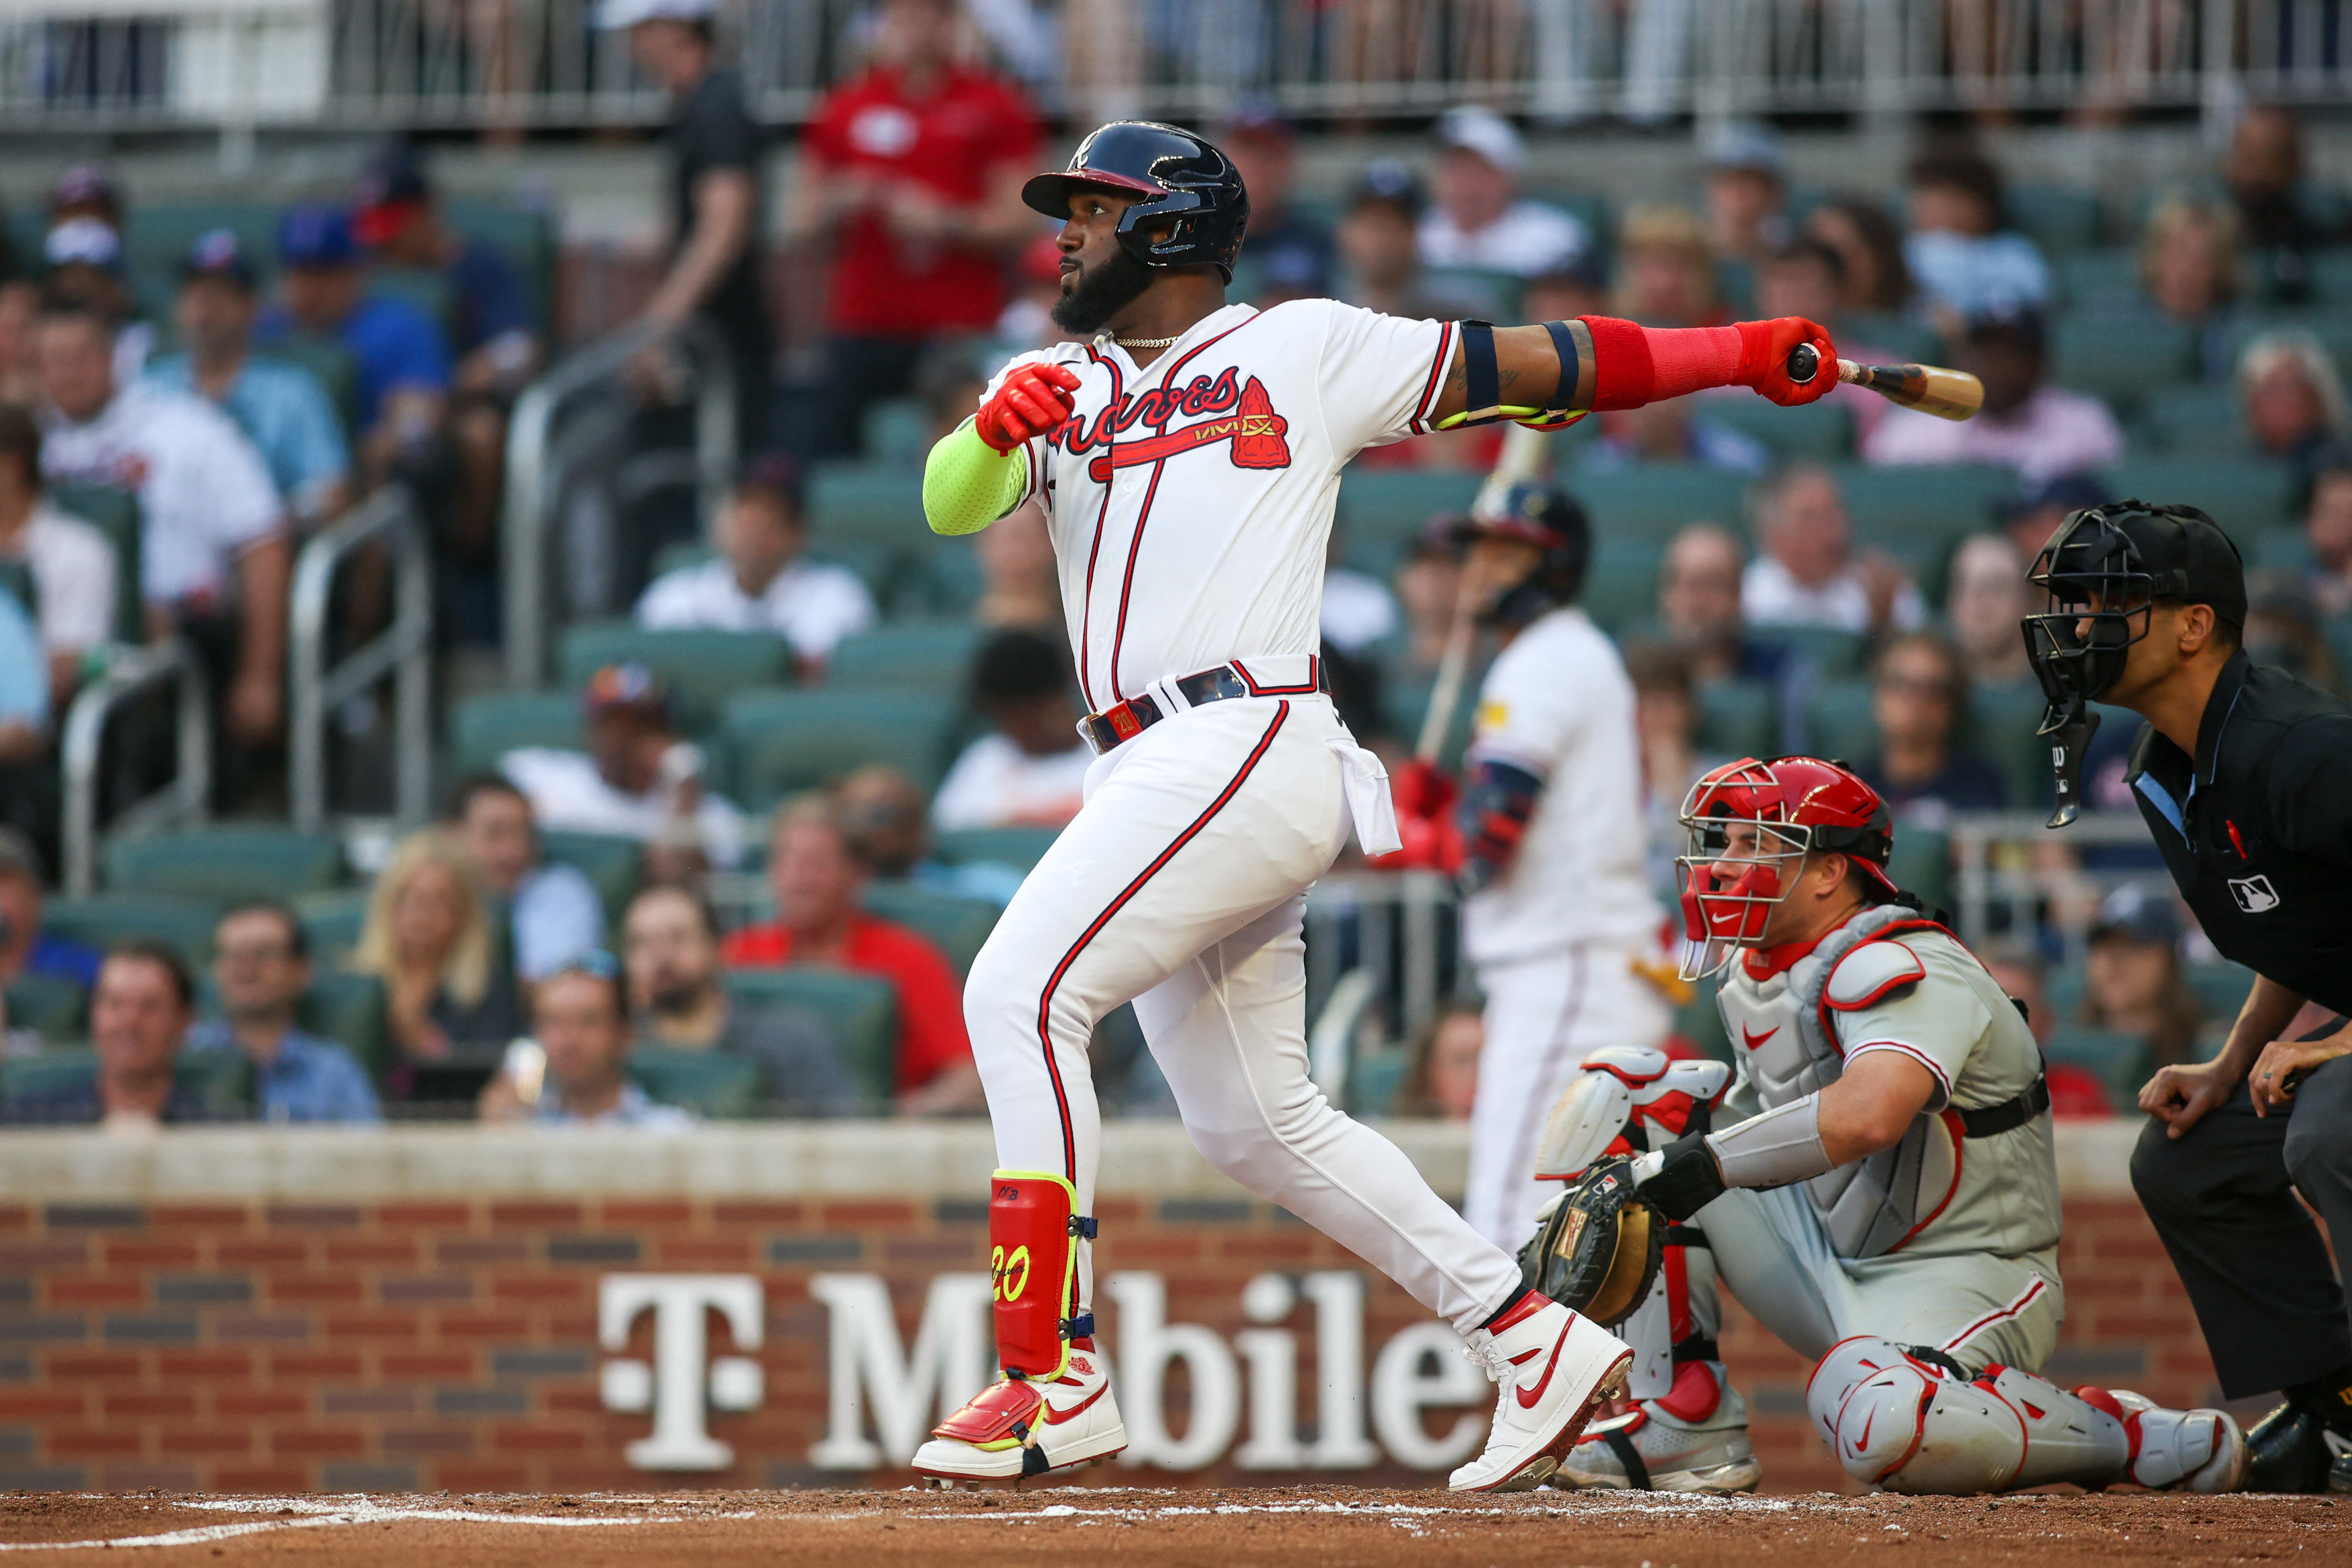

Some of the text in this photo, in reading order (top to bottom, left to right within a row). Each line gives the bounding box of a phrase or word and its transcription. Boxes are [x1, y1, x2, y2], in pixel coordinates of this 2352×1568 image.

[1046, 365, 1240, 456] raves
[1114, 712, 1133, 734] 20
[991, 1245, 1030, 1302] 20
[807, 1270, 1492, 1471] Mbile
